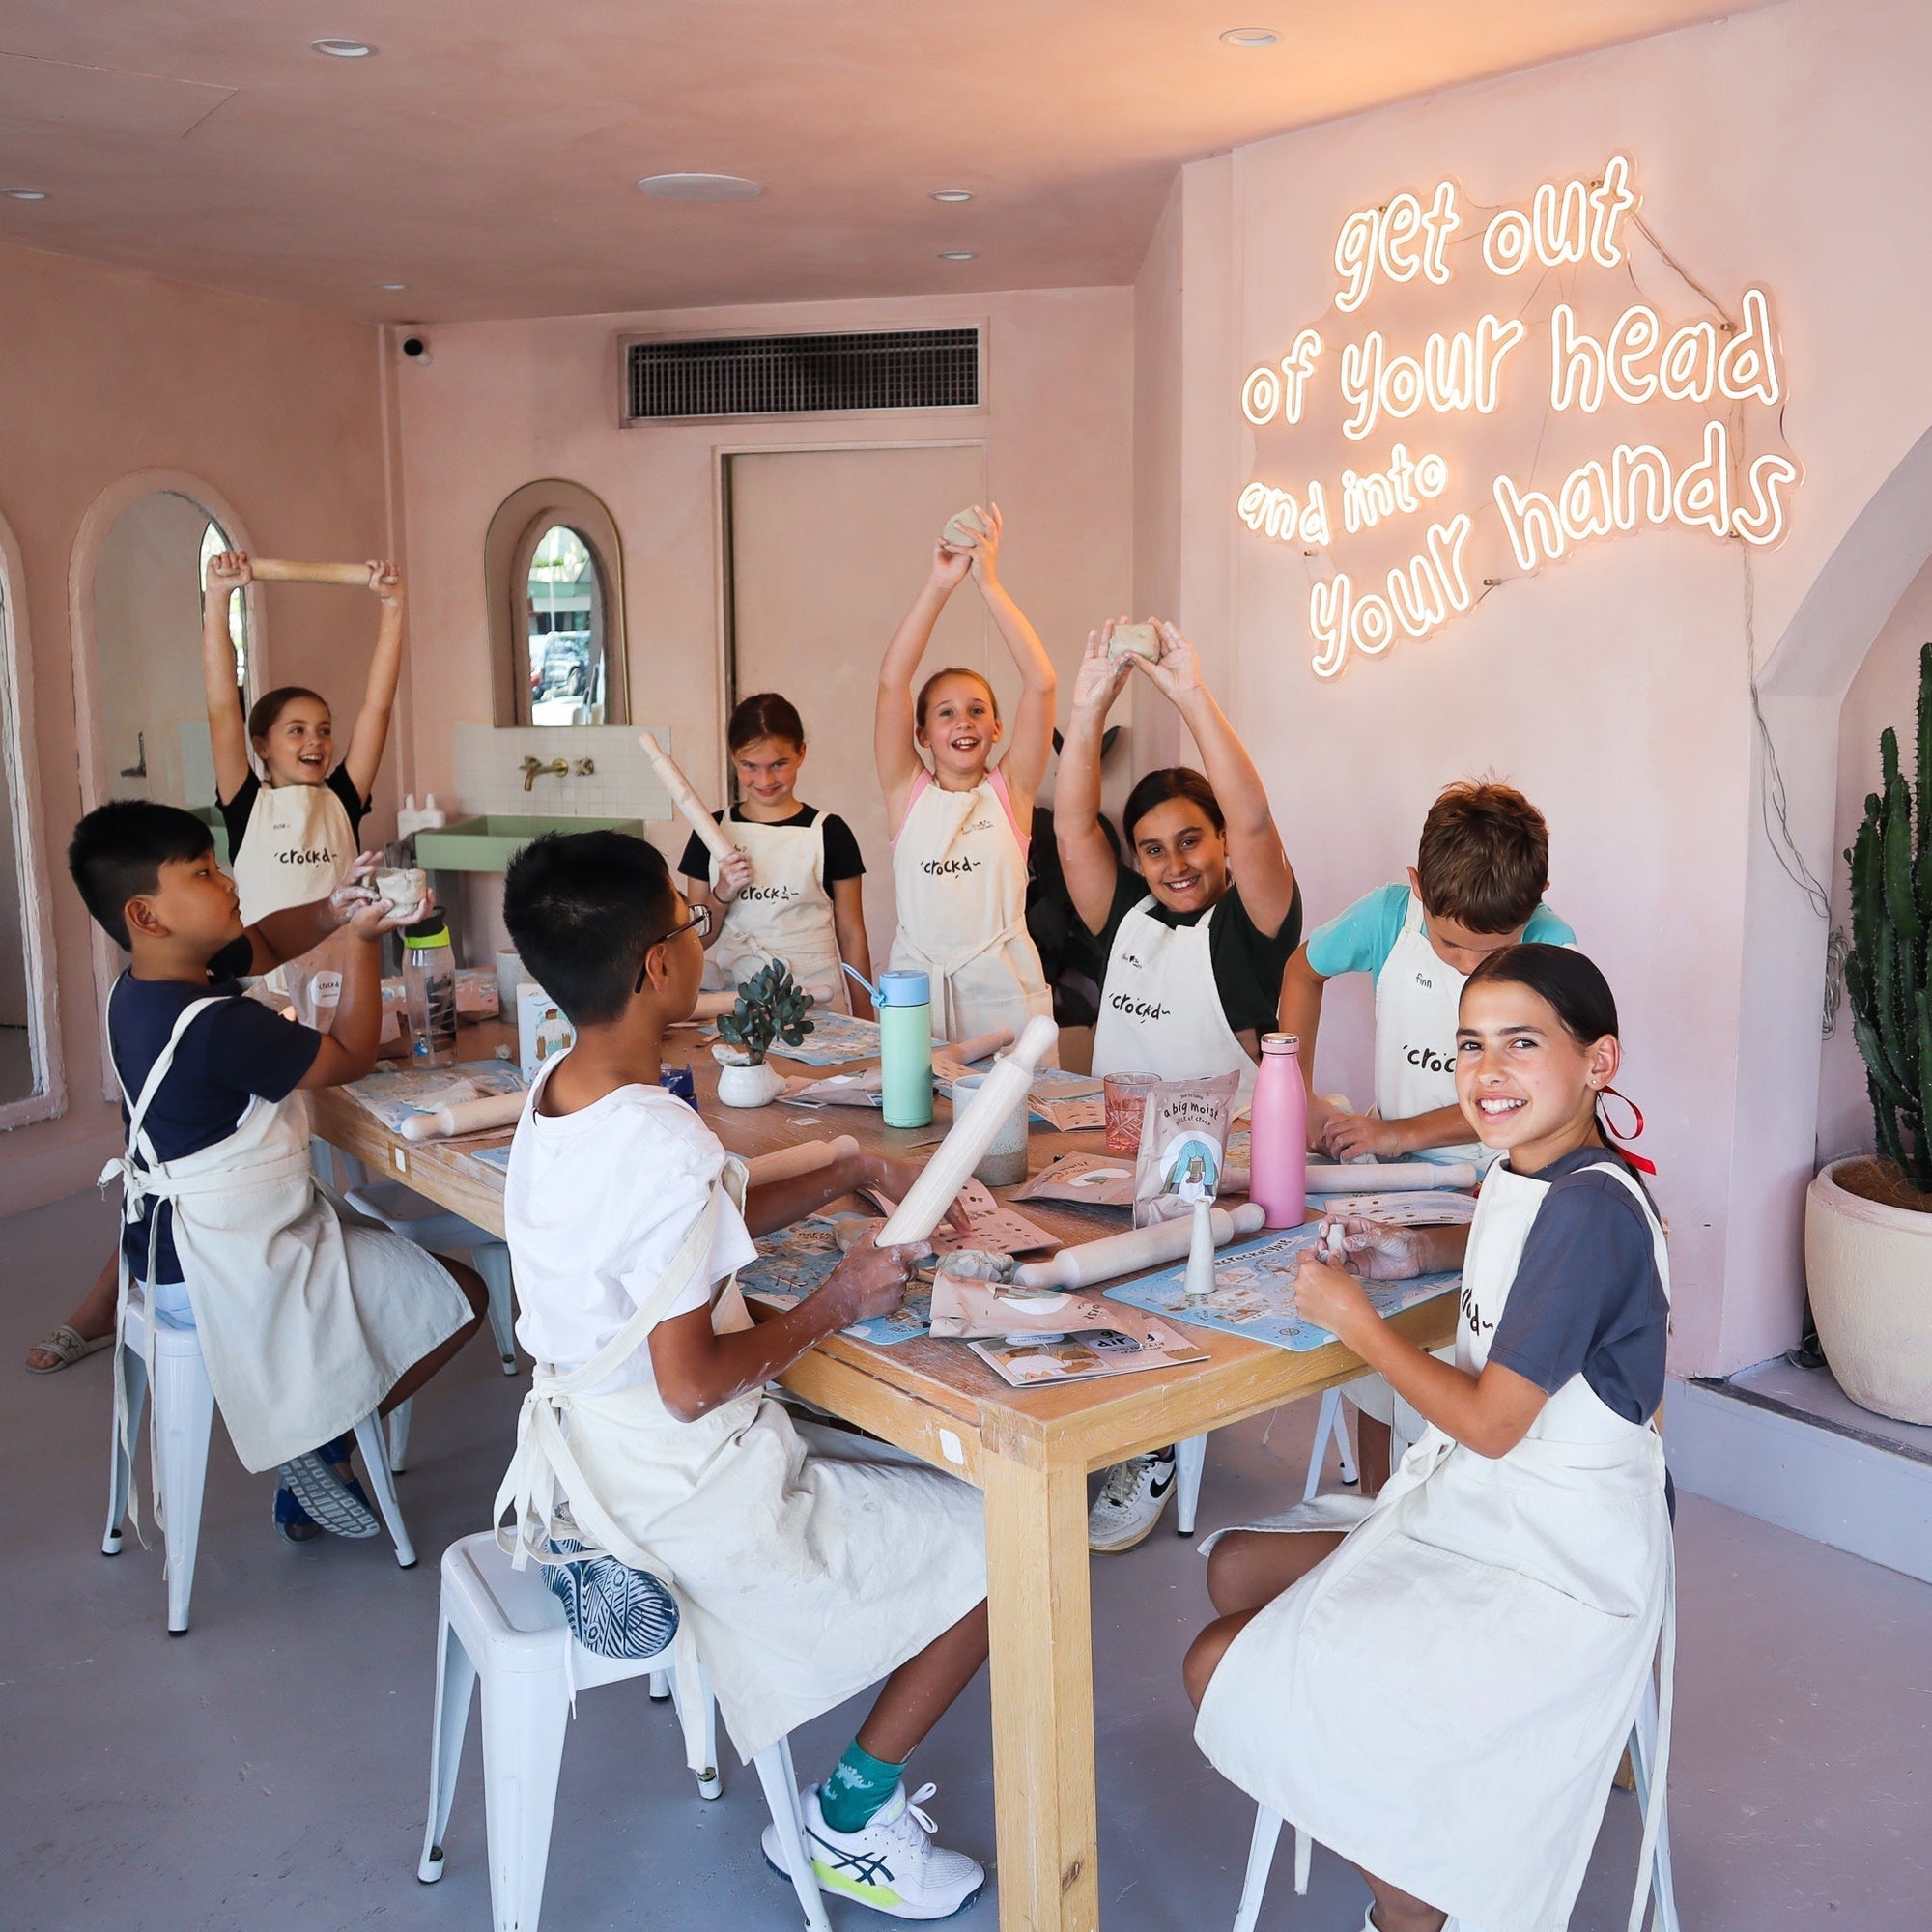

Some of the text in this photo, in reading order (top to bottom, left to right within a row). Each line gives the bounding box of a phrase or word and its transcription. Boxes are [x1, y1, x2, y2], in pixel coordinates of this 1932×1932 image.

[1334, 156, 1634, 313] get out
[1241, 289, 1780, 440] of your head
[1236, 443, 1449, 546] and into
[1309, 421, 1796, 677] your hands
[1415, 972, 1433, 989] finn
[1163, 1101, 1219, 1121] a big moist
[1406, 1048, 1457, 1073] croc
